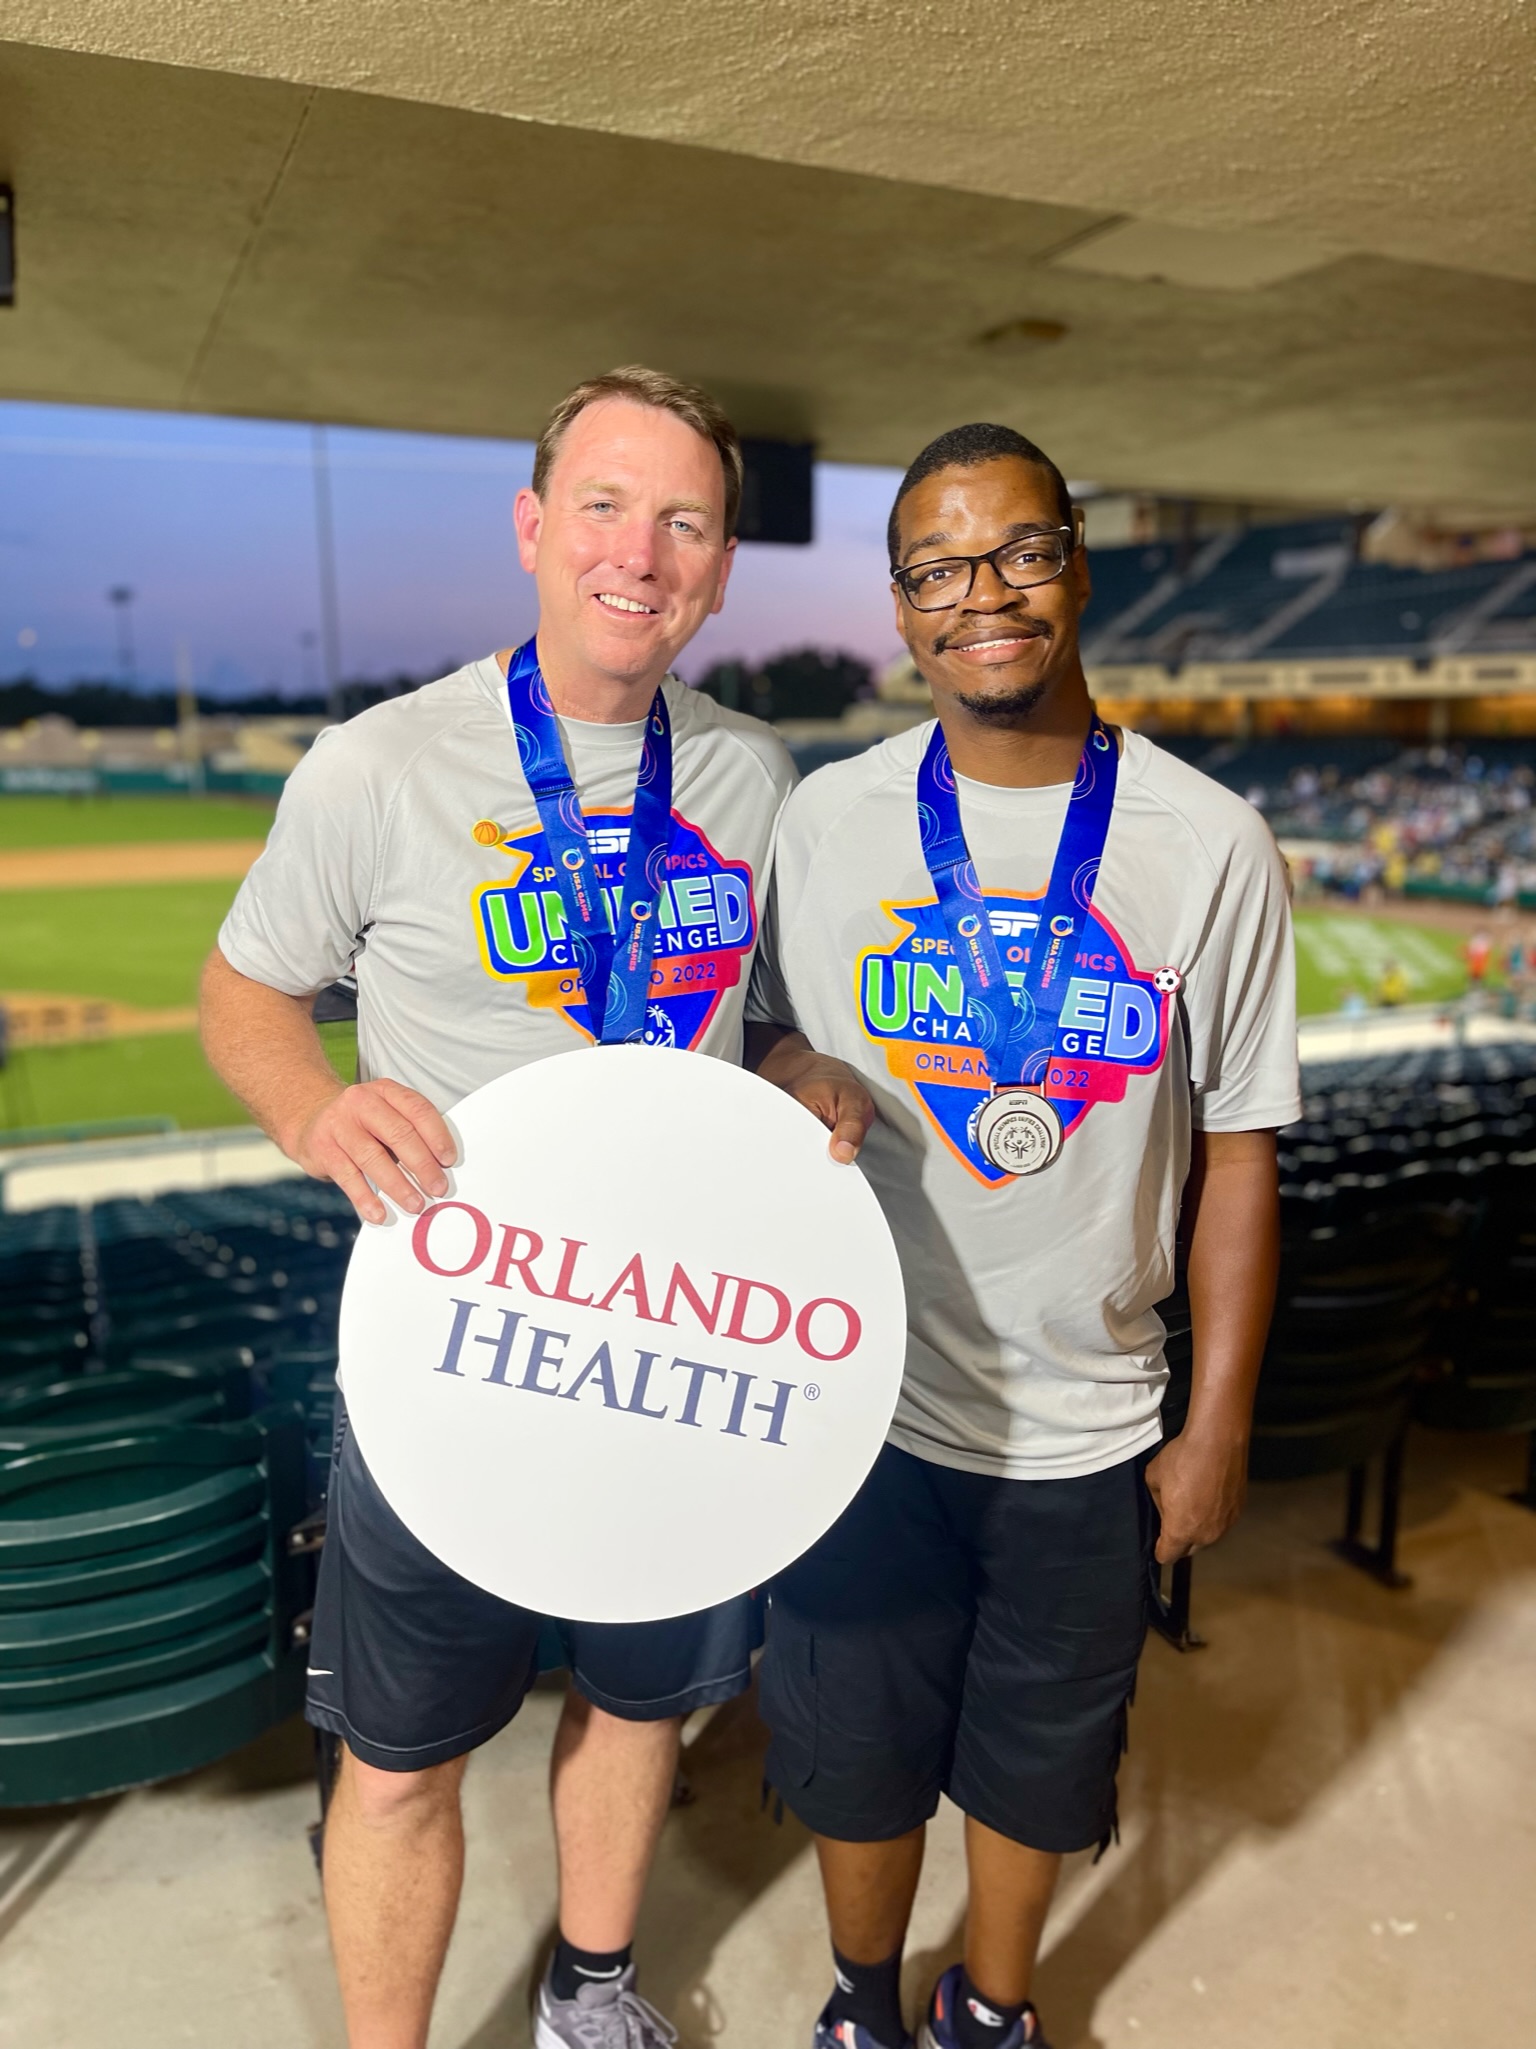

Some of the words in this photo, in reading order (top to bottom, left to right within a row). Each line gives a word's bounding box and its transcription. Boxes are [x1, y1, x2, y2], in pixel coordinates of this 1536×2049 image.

[572, 872, 582, 890] USA
[577, 891, 591, 922] GAMES
[632, 922, 642, 940] USA
[629, 941, 639, 972] GAMES
[1049, 938, 1061, 956] USA
[672, 962, 716, 984] 2022
[969, 938, 980, 957] USA
[975, 957, 990, 988] GAMES
[1041, 957, 1056, 989] GAMES
[912, 1016, 1102, 1056] CHAGE
[1050, 1067, 1090, 1089] 022
[411, 1201, 862, 1362] ORLANDO
